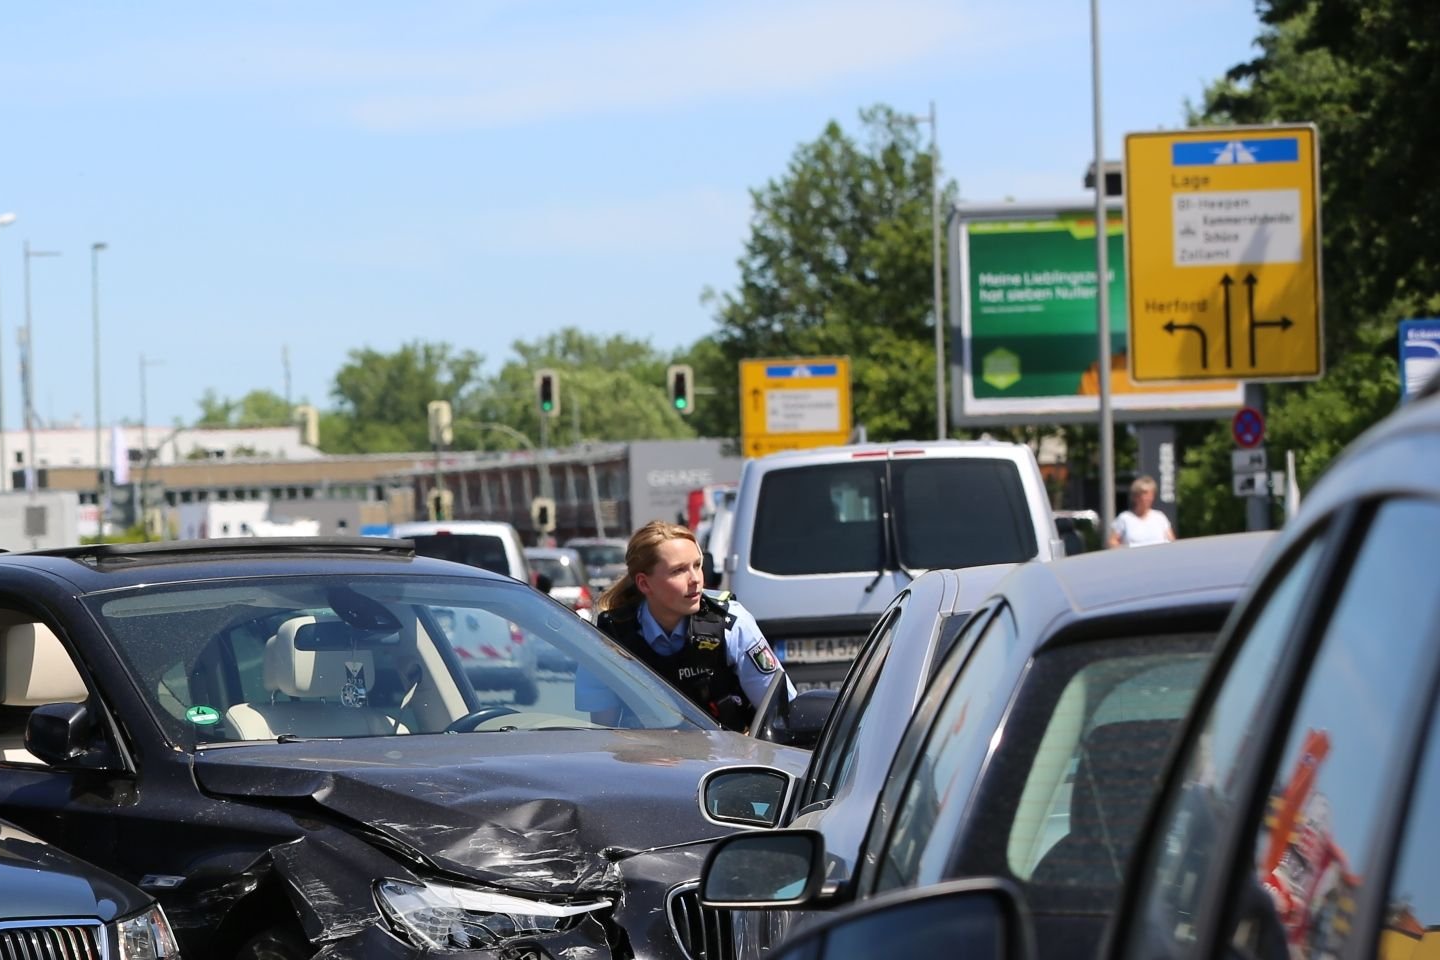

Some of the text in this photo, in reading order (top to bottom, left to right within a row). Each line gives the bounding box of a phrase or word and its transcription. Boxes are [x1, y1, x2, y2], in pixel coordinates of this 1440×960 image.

[1171, 175, 1211, 190] Lage
[978, 271, 1022, 287] Meine
[1144, 297, 1209, 314] Herford
